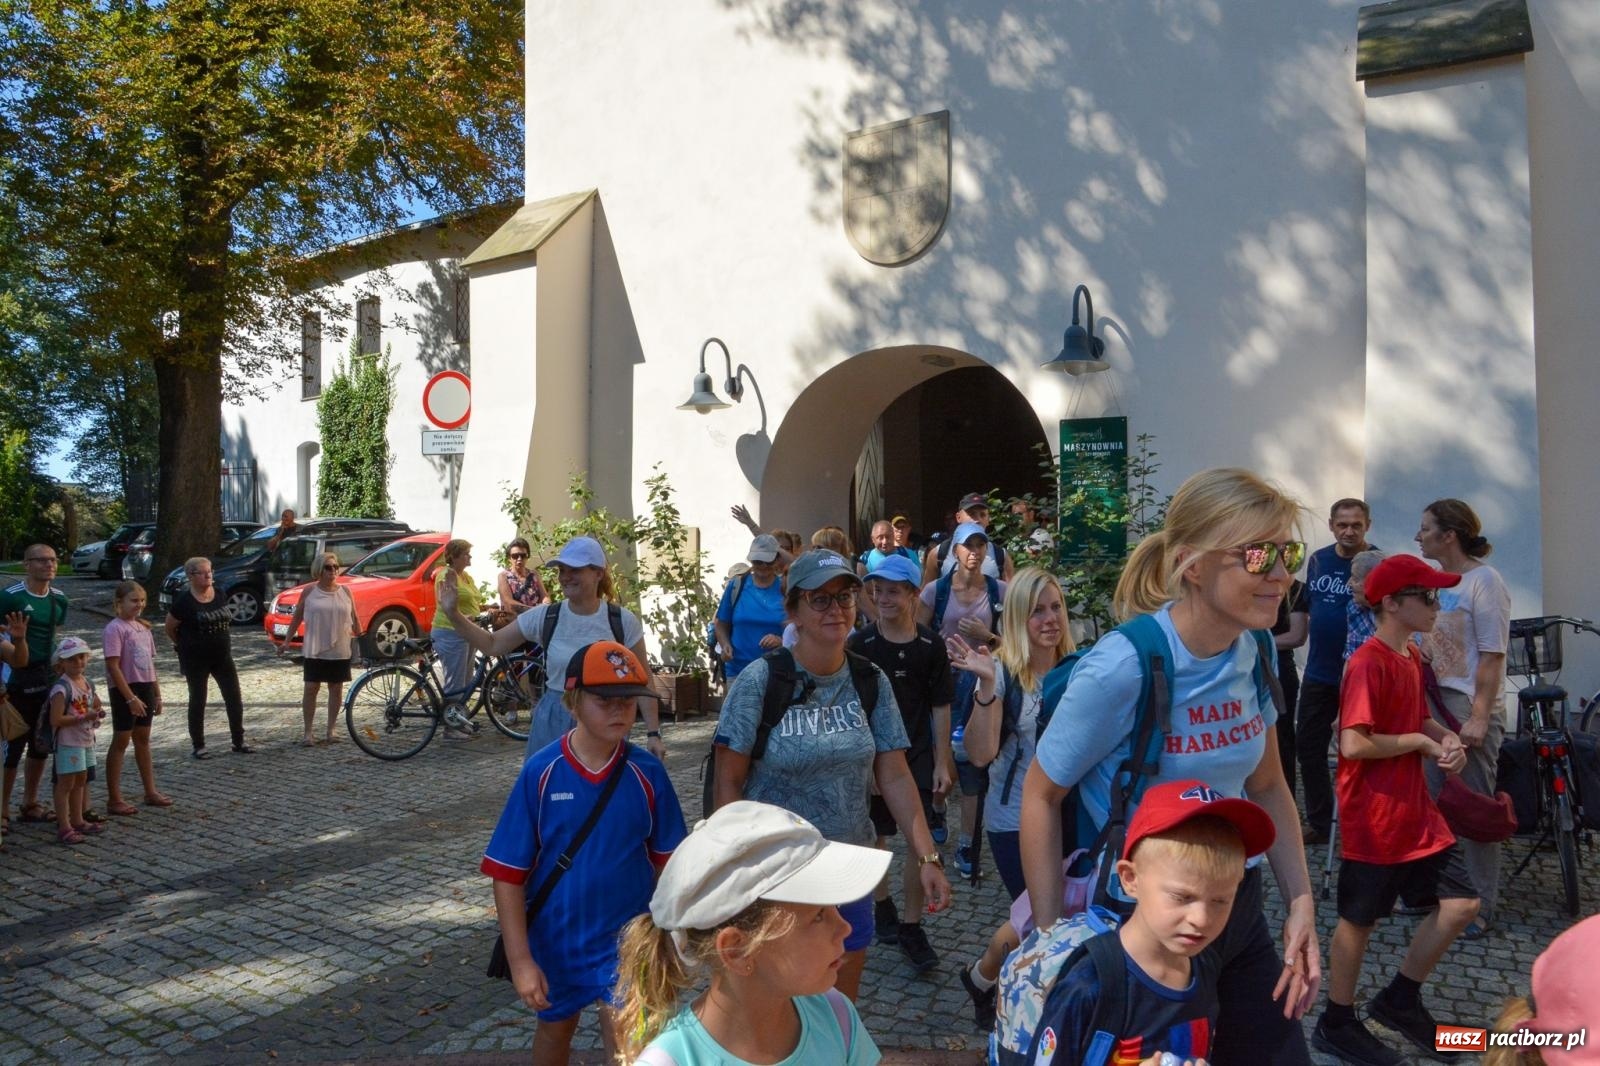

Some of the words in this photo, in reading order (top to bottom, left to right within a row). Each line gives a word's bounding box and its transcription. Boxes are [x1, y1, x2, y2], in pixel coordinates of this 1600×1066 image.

[1063, 441, 1124, 452] MASZYNOWNIA
[1309, 575, 1353, 595] s.Olive
[1187, 700, 1242, 726] MAIN
[1165, 713, 1264, 754] HARACTE
